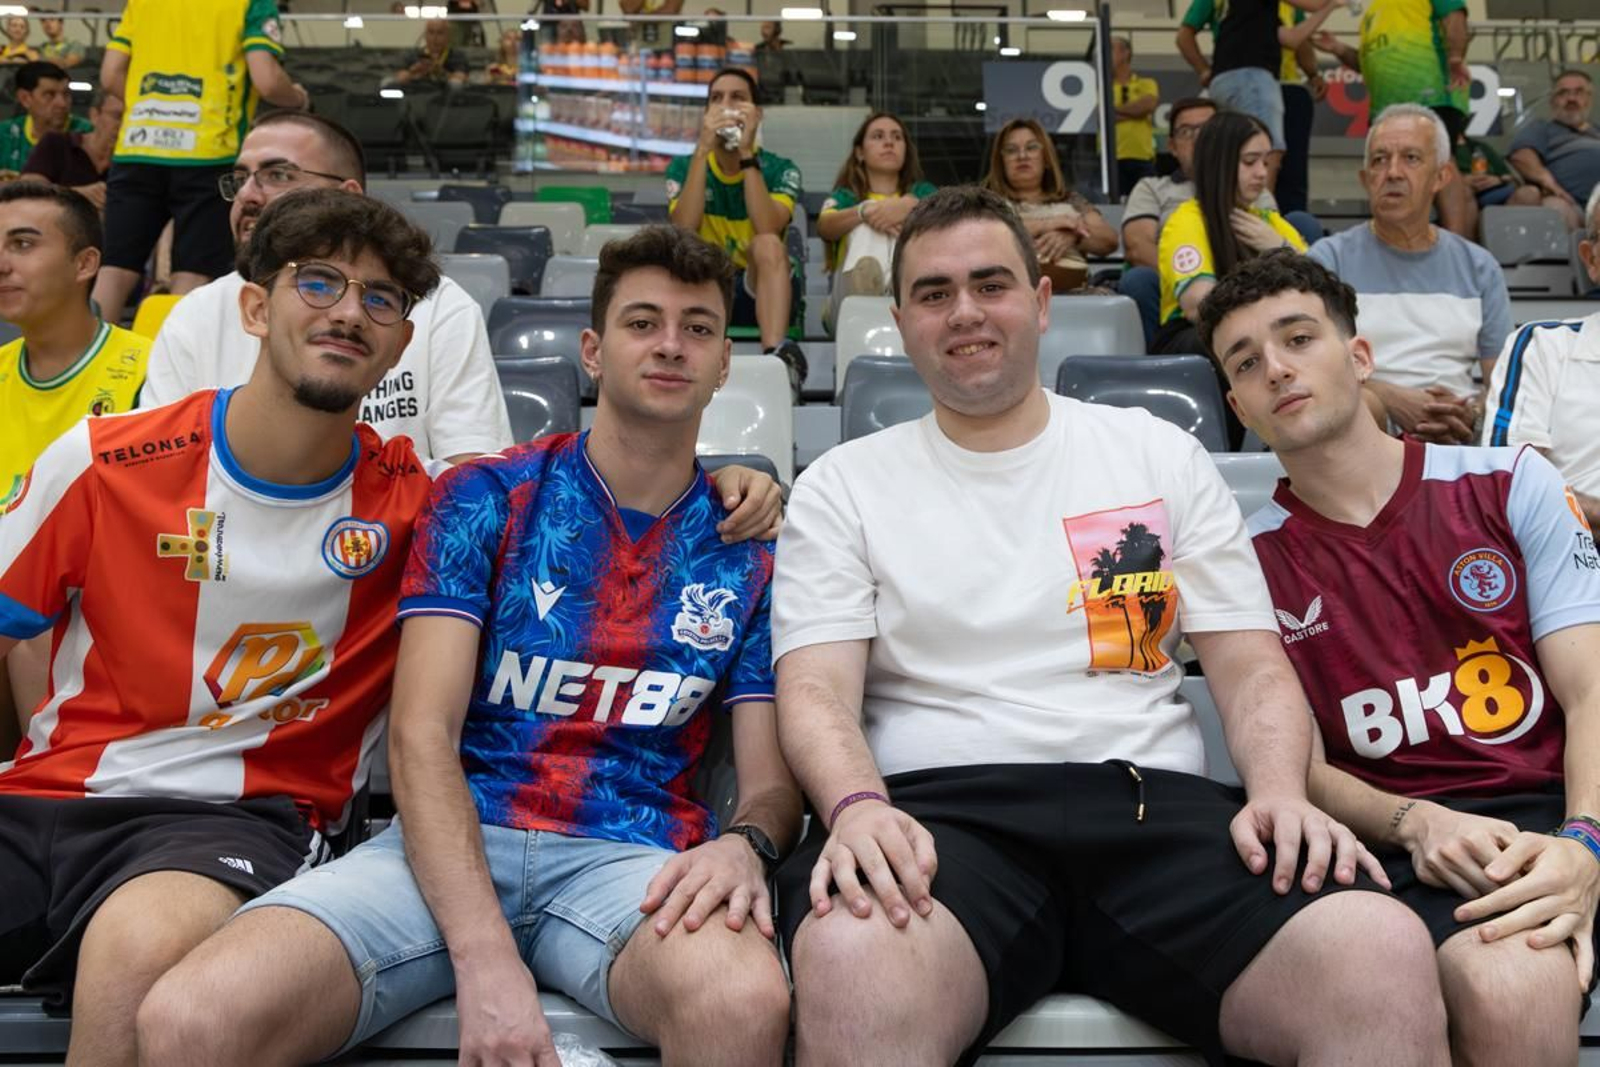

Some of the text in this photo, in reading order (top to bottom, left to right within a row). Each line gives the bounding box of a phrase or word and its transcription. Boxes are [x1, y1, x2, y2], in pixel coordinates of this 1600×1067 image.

[1042, 61, 1097, 132] 9
[1326, 80, 1371, 137] 9
[358, 397, 418, 423] ANGES
[367, 371, 414, 399] HING
[1283, 621, 1329, 645] CASTORE
[487, 650, 716, 726] NET88
[1341, 653, 1526, 760] BK8
